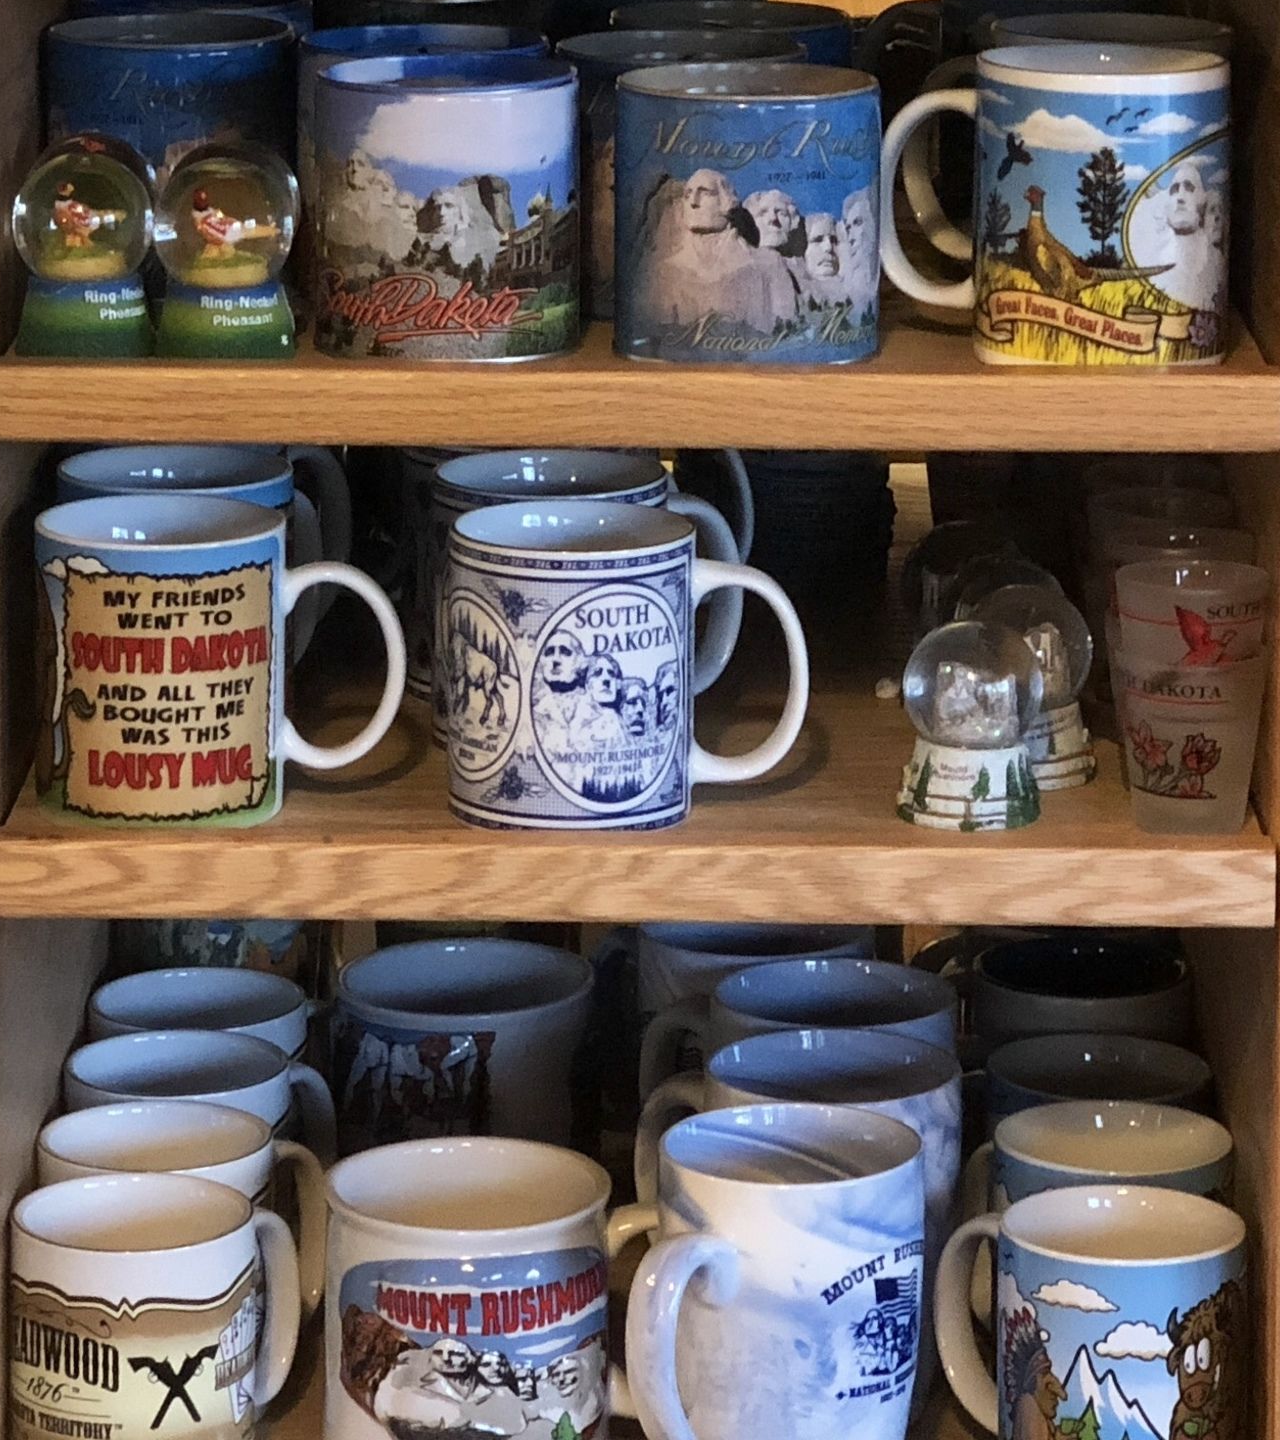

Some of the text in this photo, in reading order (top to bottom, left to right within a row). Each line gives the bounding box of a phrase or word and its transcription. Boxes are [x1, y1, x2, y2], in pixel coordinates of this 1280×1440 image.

[324, 268, 543, 342] South Dakota
[995, 296, 1021, 314] Great
[1063, 306, 1098, 333] Great
[213, 312, 274, 327] Pheasant
[663, 309, 788, 352] National
[103, 584, 246, 607] MY FRIENDS
[118, 610, 233, 630] WENT TO
[574, 603, 650, 630] SOUTH
[71, 626, 268, 675] SOUTH DAKOTA
[592, 625, 672, 655] DAKOTA
[97, 677, 254, 702] AND ALL THEY
[1141, 678, 1222, 699] DAKOTA
[103, 700, 245, 724] BOUGHT ME
[121, 723, 232, 745] WAS THIS
[88, 744, 253, 791] LOUSY MUG
[556, 746, 667, 764] MOUNT RUSHMORE
[820, 1255, 886, 1305] MOUNT
[376, 1282, 472, 1336] MOUNT
[13, 1316, 119, 1392] ADWOOD
[26, 1376, 67, 1403] 1876
[848, 1379, 891, 1399] NATIONAL
[38, 1411, 113, 1440] TERRITORY
